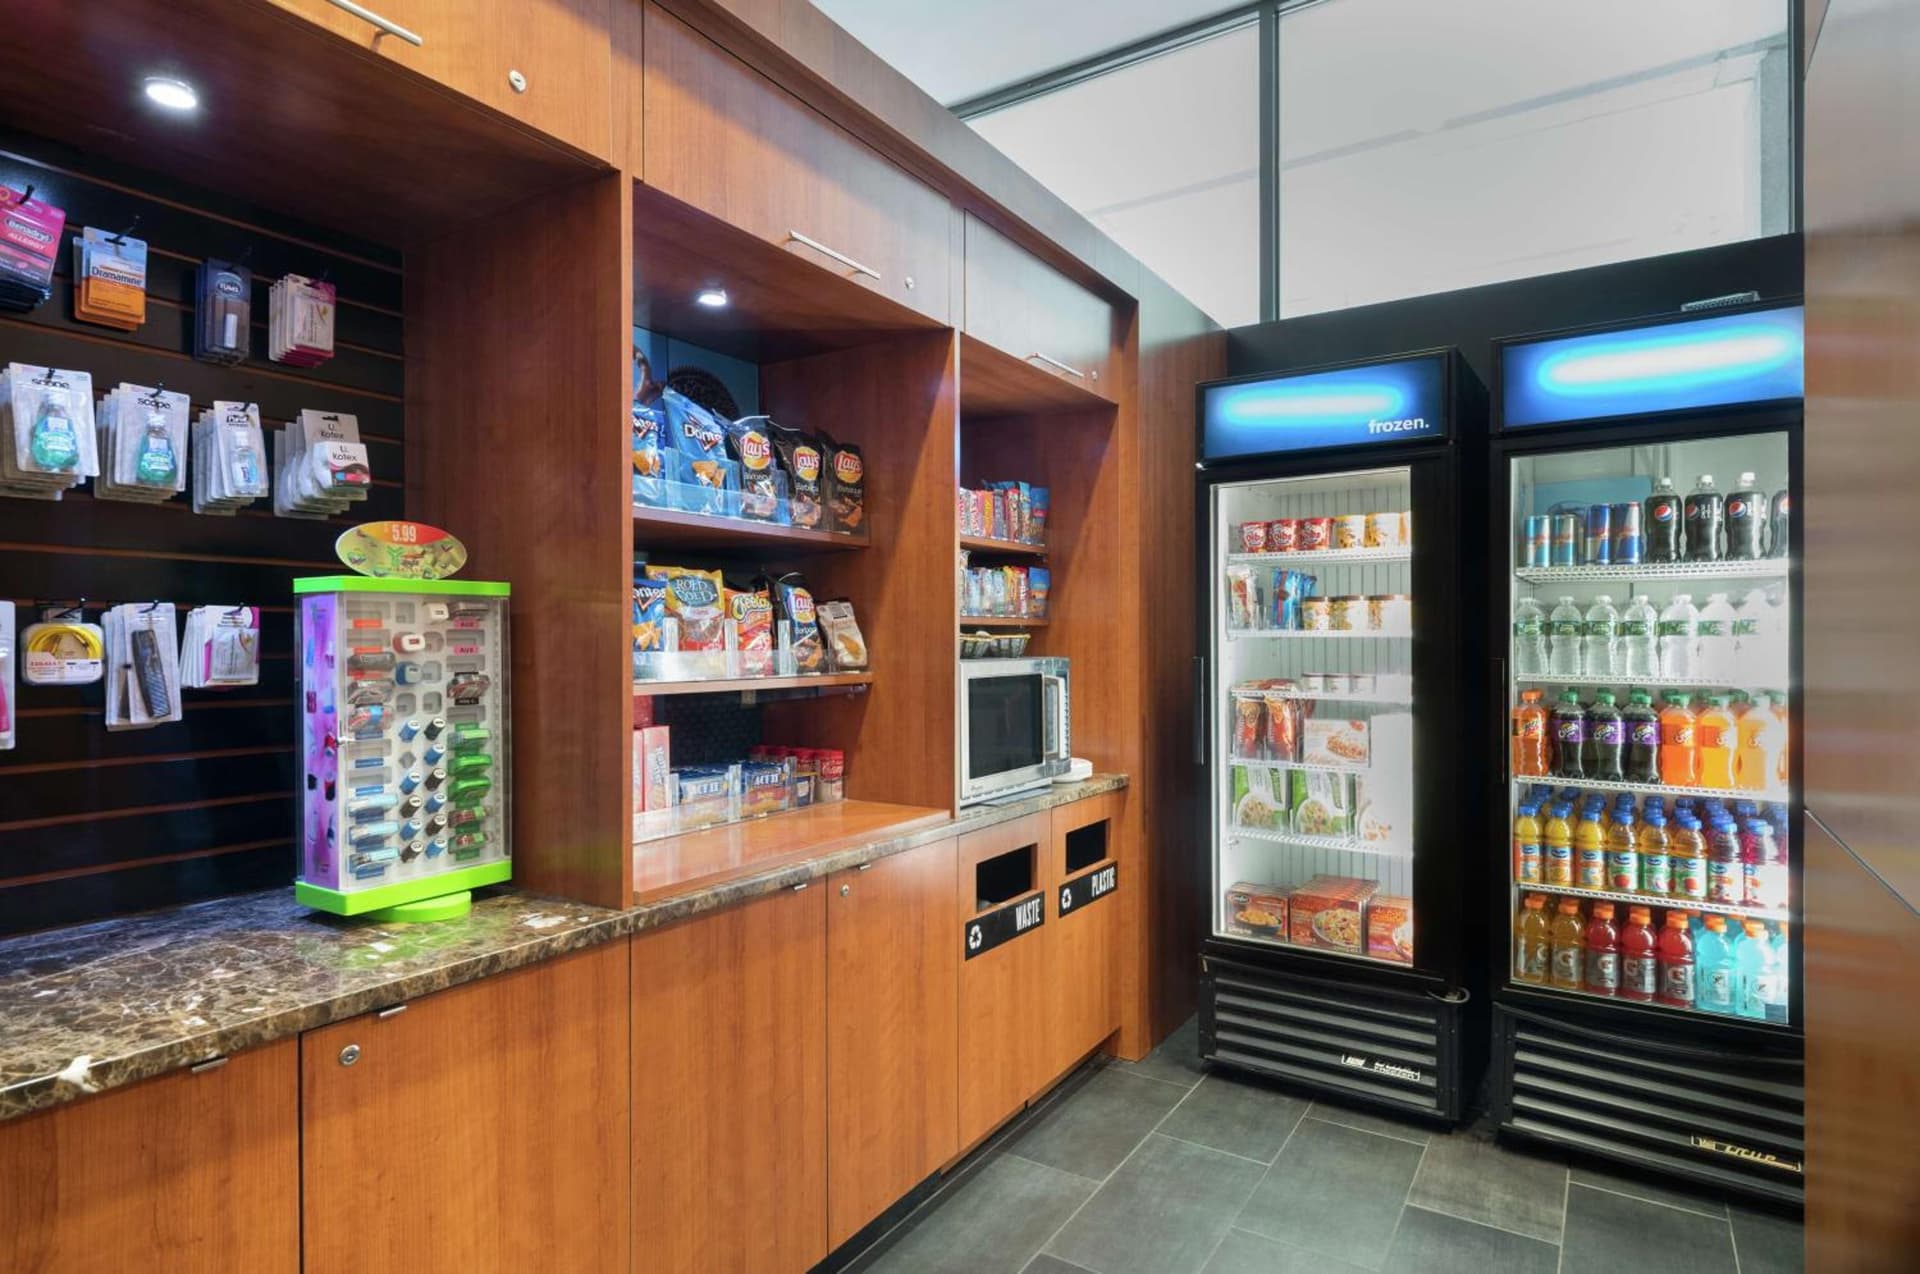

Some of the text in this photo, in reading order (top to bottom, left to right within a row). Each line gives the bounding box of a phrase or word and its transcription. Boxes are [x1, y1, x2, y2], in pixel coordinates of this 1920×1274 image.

[8, 219, 52, 242] Benadryl
[91, 266, 143, 286] Dramamine
[1368, 417, 1430, 435] frozen.
[743, 437, 771, 457] Lay's
[797, 452, 820, 469] Lay's
[838, 452, 862, 473] Lay's
[391, 524, 417, 543] 5.99
[1091, 866, 1115, 898] PLASTIC
[1016, 898, 1041, 932] WASTE
